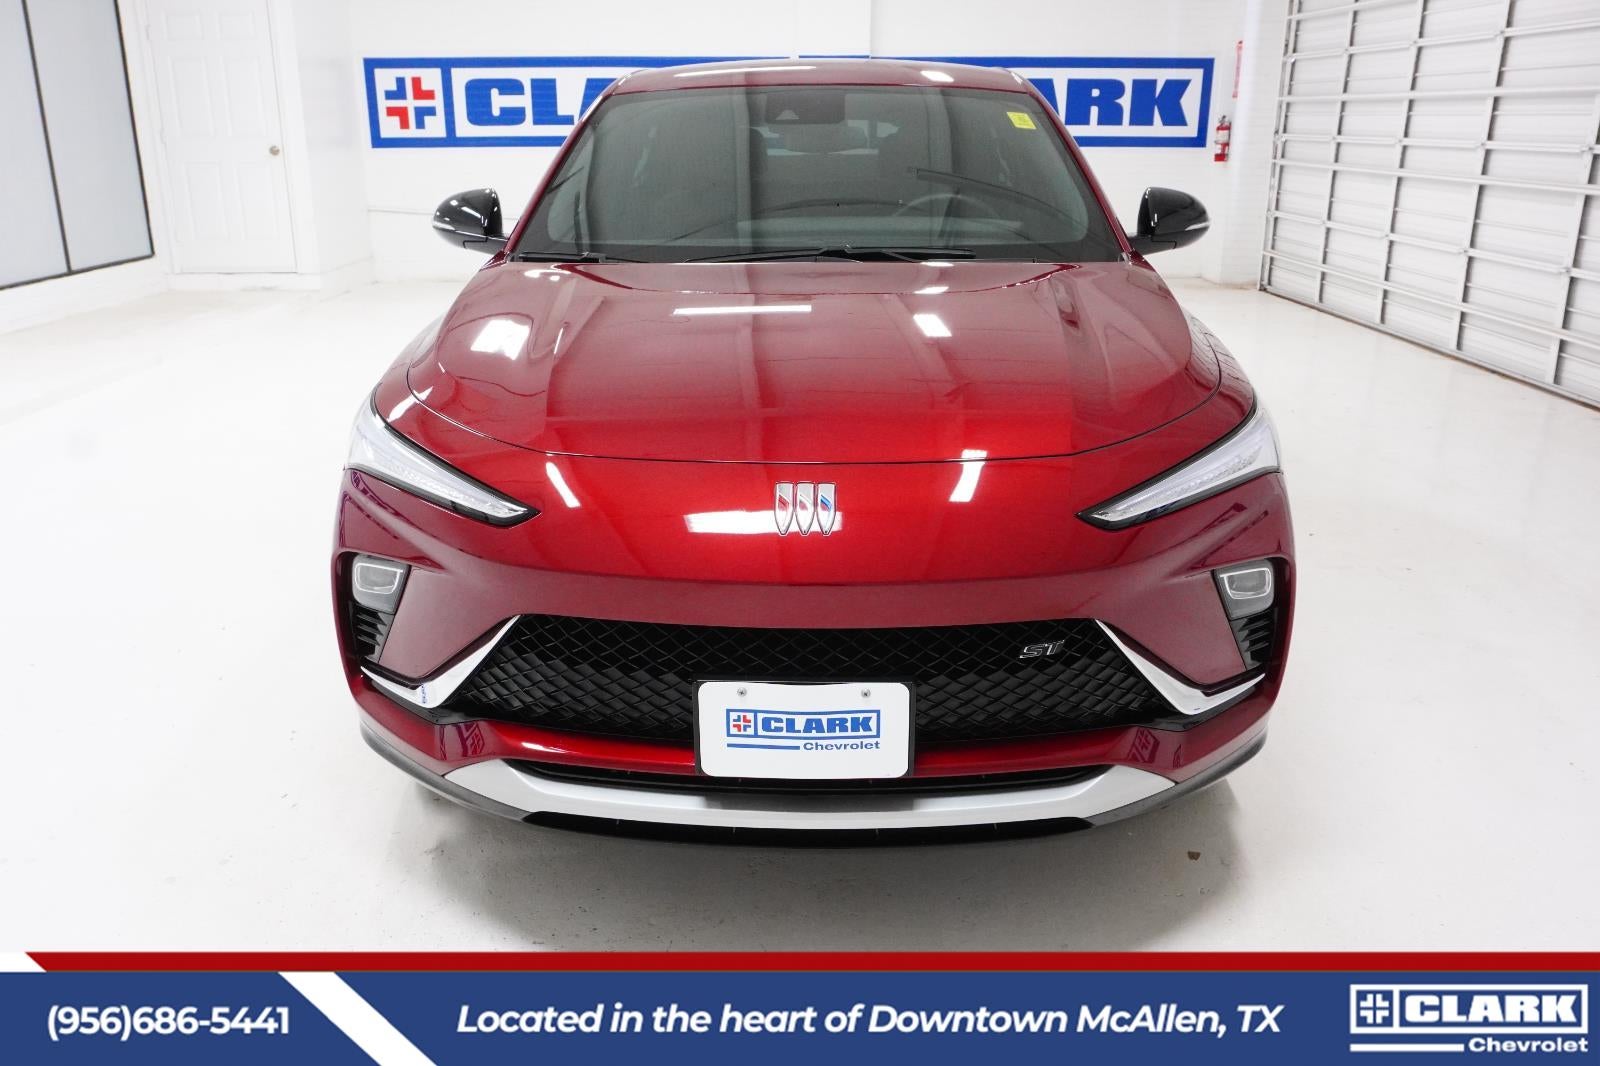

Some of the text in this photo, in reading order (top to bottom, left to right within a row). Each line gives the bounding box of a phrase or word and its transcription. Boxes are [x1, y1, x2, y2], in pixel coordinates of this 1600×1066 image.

[1019, 639, 1065, 659] ST
[761, 716, 873, 734] CLARK
[803, 740, 881, 751] Chevrolet
